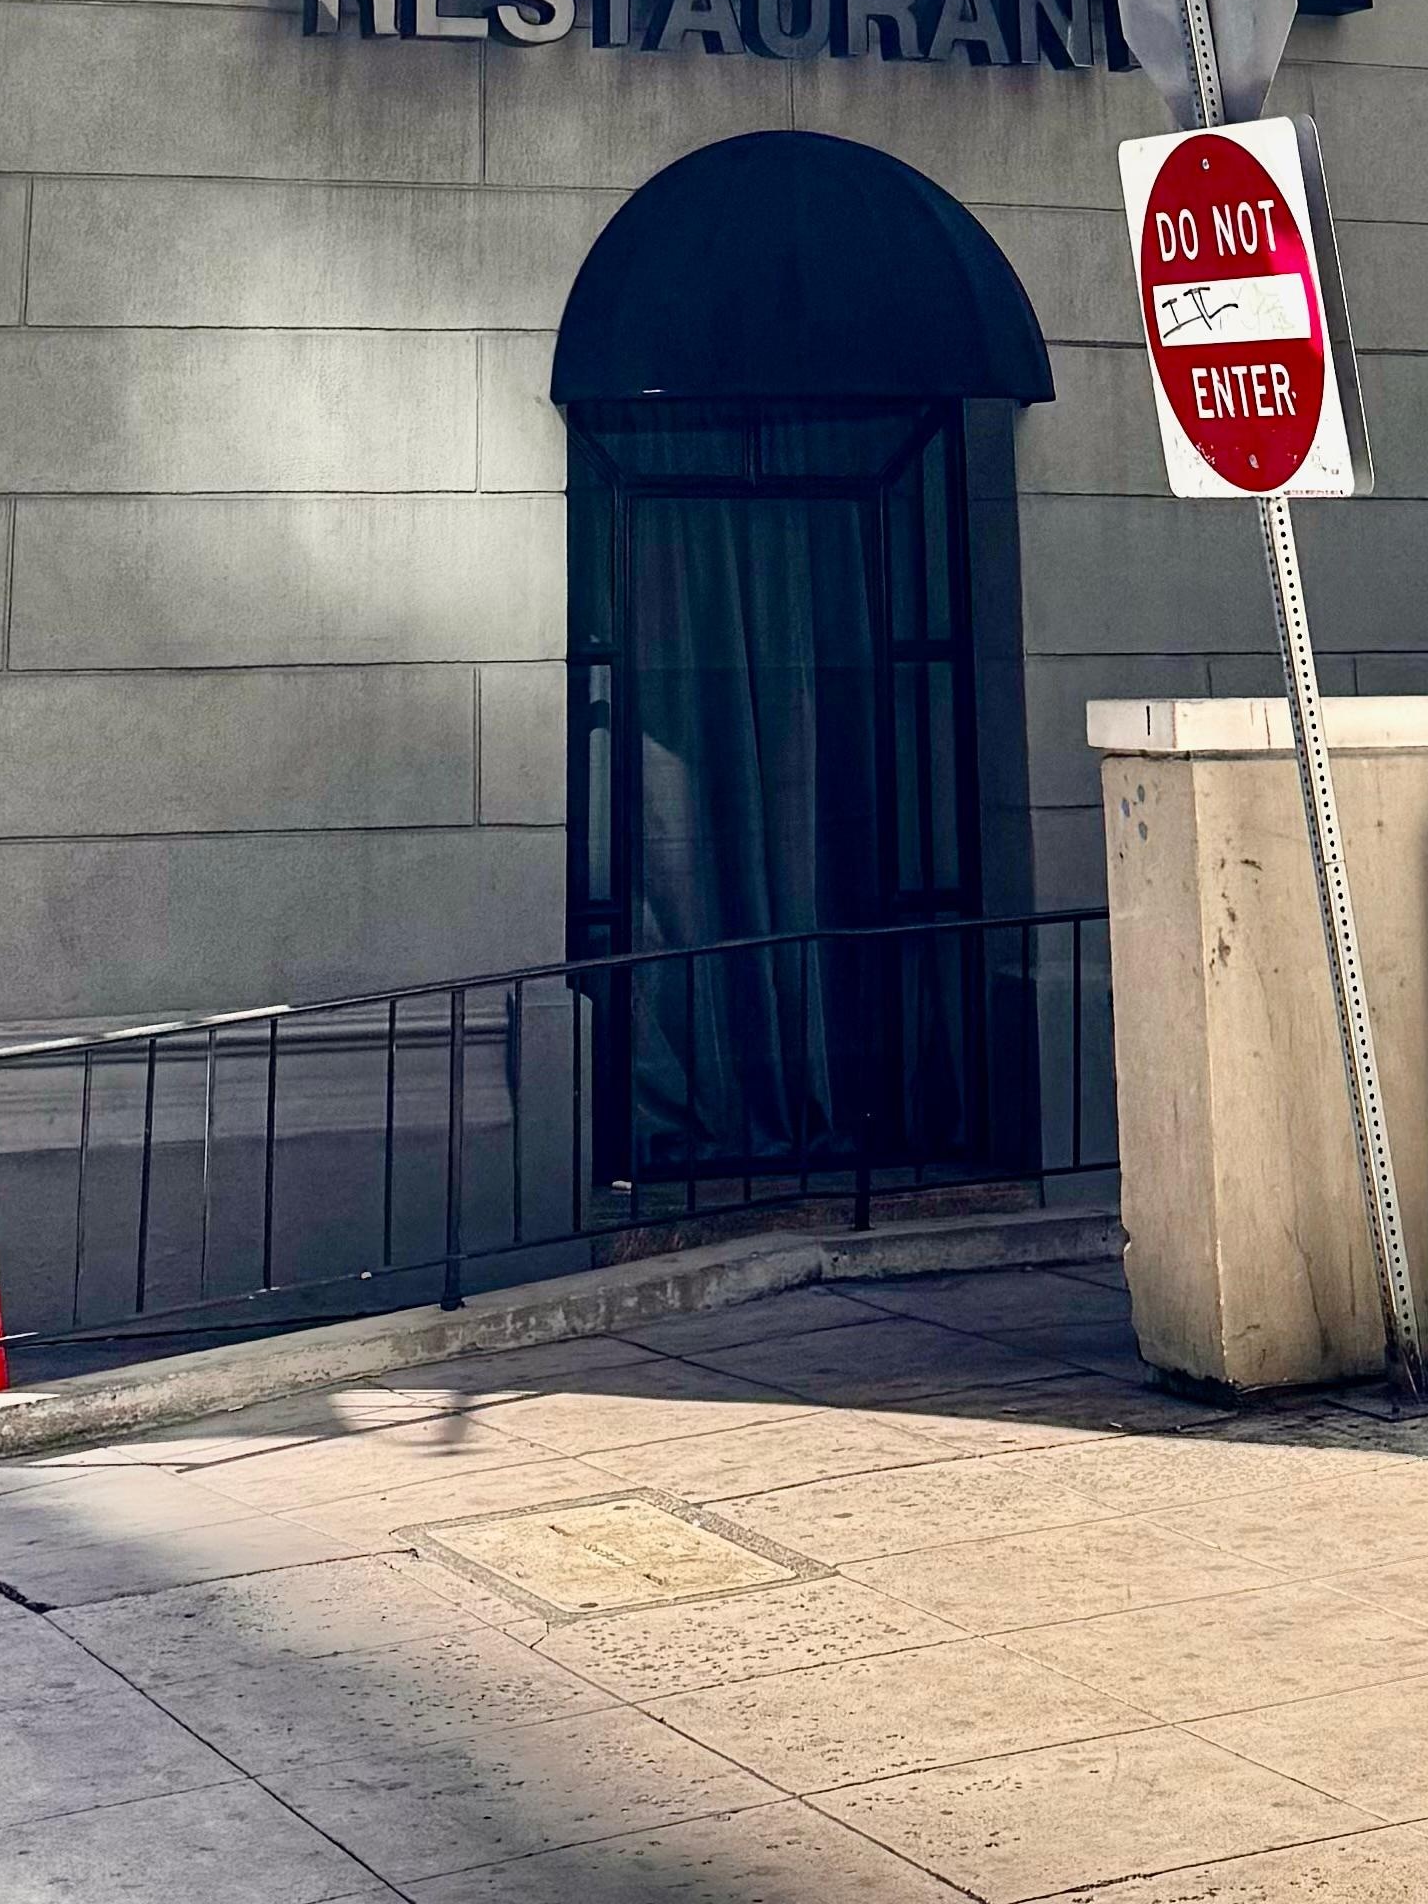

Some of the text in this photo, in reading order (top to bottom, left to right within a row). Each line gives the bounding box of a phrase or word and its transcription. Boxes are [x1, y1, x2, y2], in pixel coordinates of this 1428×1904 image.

[1156, 200, 1276, 262] DO NOT
[1191, 364, 1297, 419] ENTER
